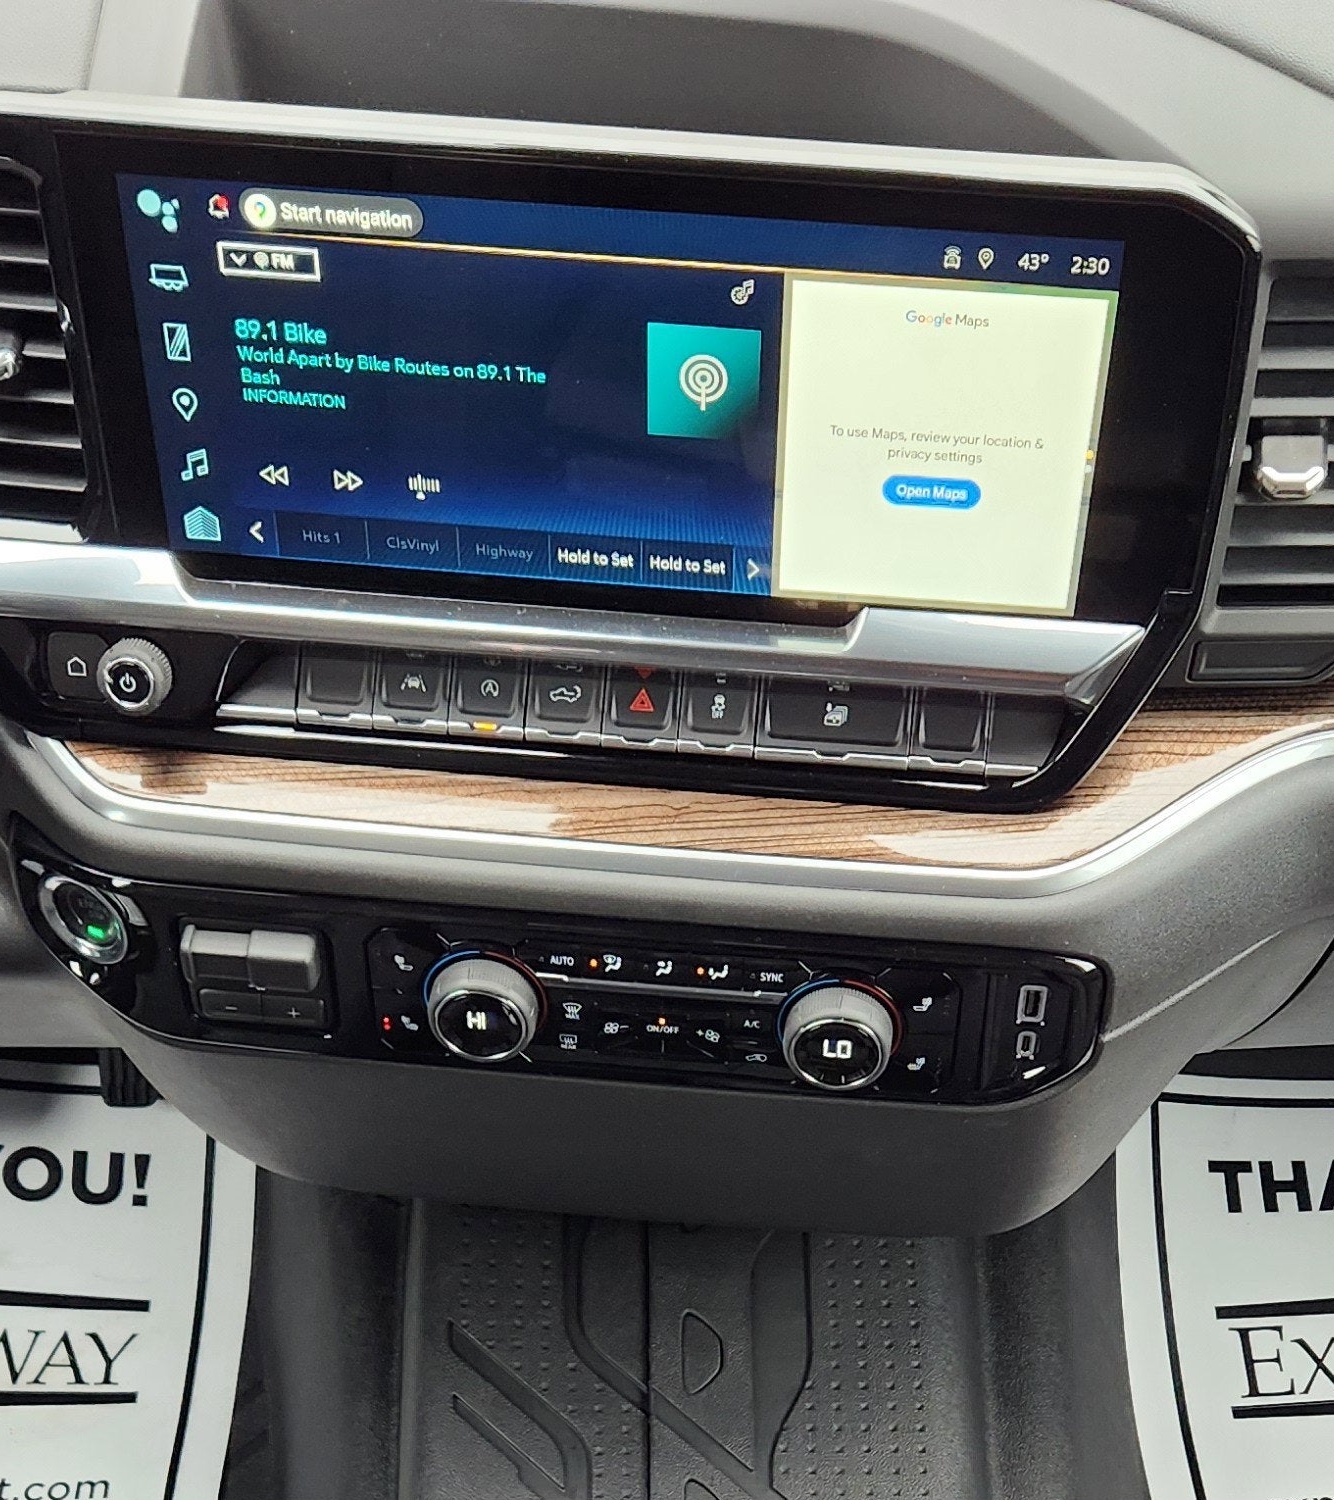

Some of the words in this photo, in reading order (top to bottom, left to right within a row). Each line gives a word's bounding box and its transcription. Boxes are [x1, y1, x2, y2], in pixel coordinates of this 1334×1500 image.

[280, 202, 322, 224] Start
[325, 207, 413, 230] navigation
[271, 253, 295, 271] FM
[1017, 252, 1050, 272] 43°
[1070, 255, 1110, 276] 2:30
[906, 310, 952, 327] Google
[955, 313, 989, 329] Maps
[234, 318, 277, 341] 89.1
[283, 321, 327, 345] Bike
[236, 345, 284, 364] World
[287, 349, 332, 369] Apart
[335, 352, 354, 373] by
[357, 354, 390, 372] Bike
[394, 357, 450, 377] Routes
[453, 365, 474, 379] on
[476, 363, 511, 382] 89.1
[515, 365, 546, 384] The
[240, 367, 281, 386] Bash
[242, 388, 346, 410] INFORMATION
[830, 425, 844, 437] To
[846, 427, 869, 438] use
[872, 427, 908, 442] Maps,
[911, 431, 951, 444] review
[953, 434, 980, 447] your
[983, 435, 1032, 449] location
[1034, 438, 1044, 449] &
[887, 448, 932, 463] privacy
[934, 450, 983, 466] settings
[896, 483, 931, 498] Open
[932, 485, 968, 502] Maps
[302, 529, 330, 544] Hits
[386, 537, 440, 555] ClsVinyl
[475, 543, 534, 562] Highway
[557, 546, 591, 564] Hold
[593, 551, 609, 566] to
[611, 551, 634, 568] Set
[649, 554, 683, 571] Hold
[685, 558, 701, 573] to
[703, 558, 726, 575] Set
[550, 954, 574, 967] AUTO
[760, 972, 784, 983] SYNC
[466, 1011, 487, 1030] HI
[646, 1025, 680, 1034] ON/OFF
[743, 1019, 761, 1029] A/C
[822, 1038, 853, 1059] LO
